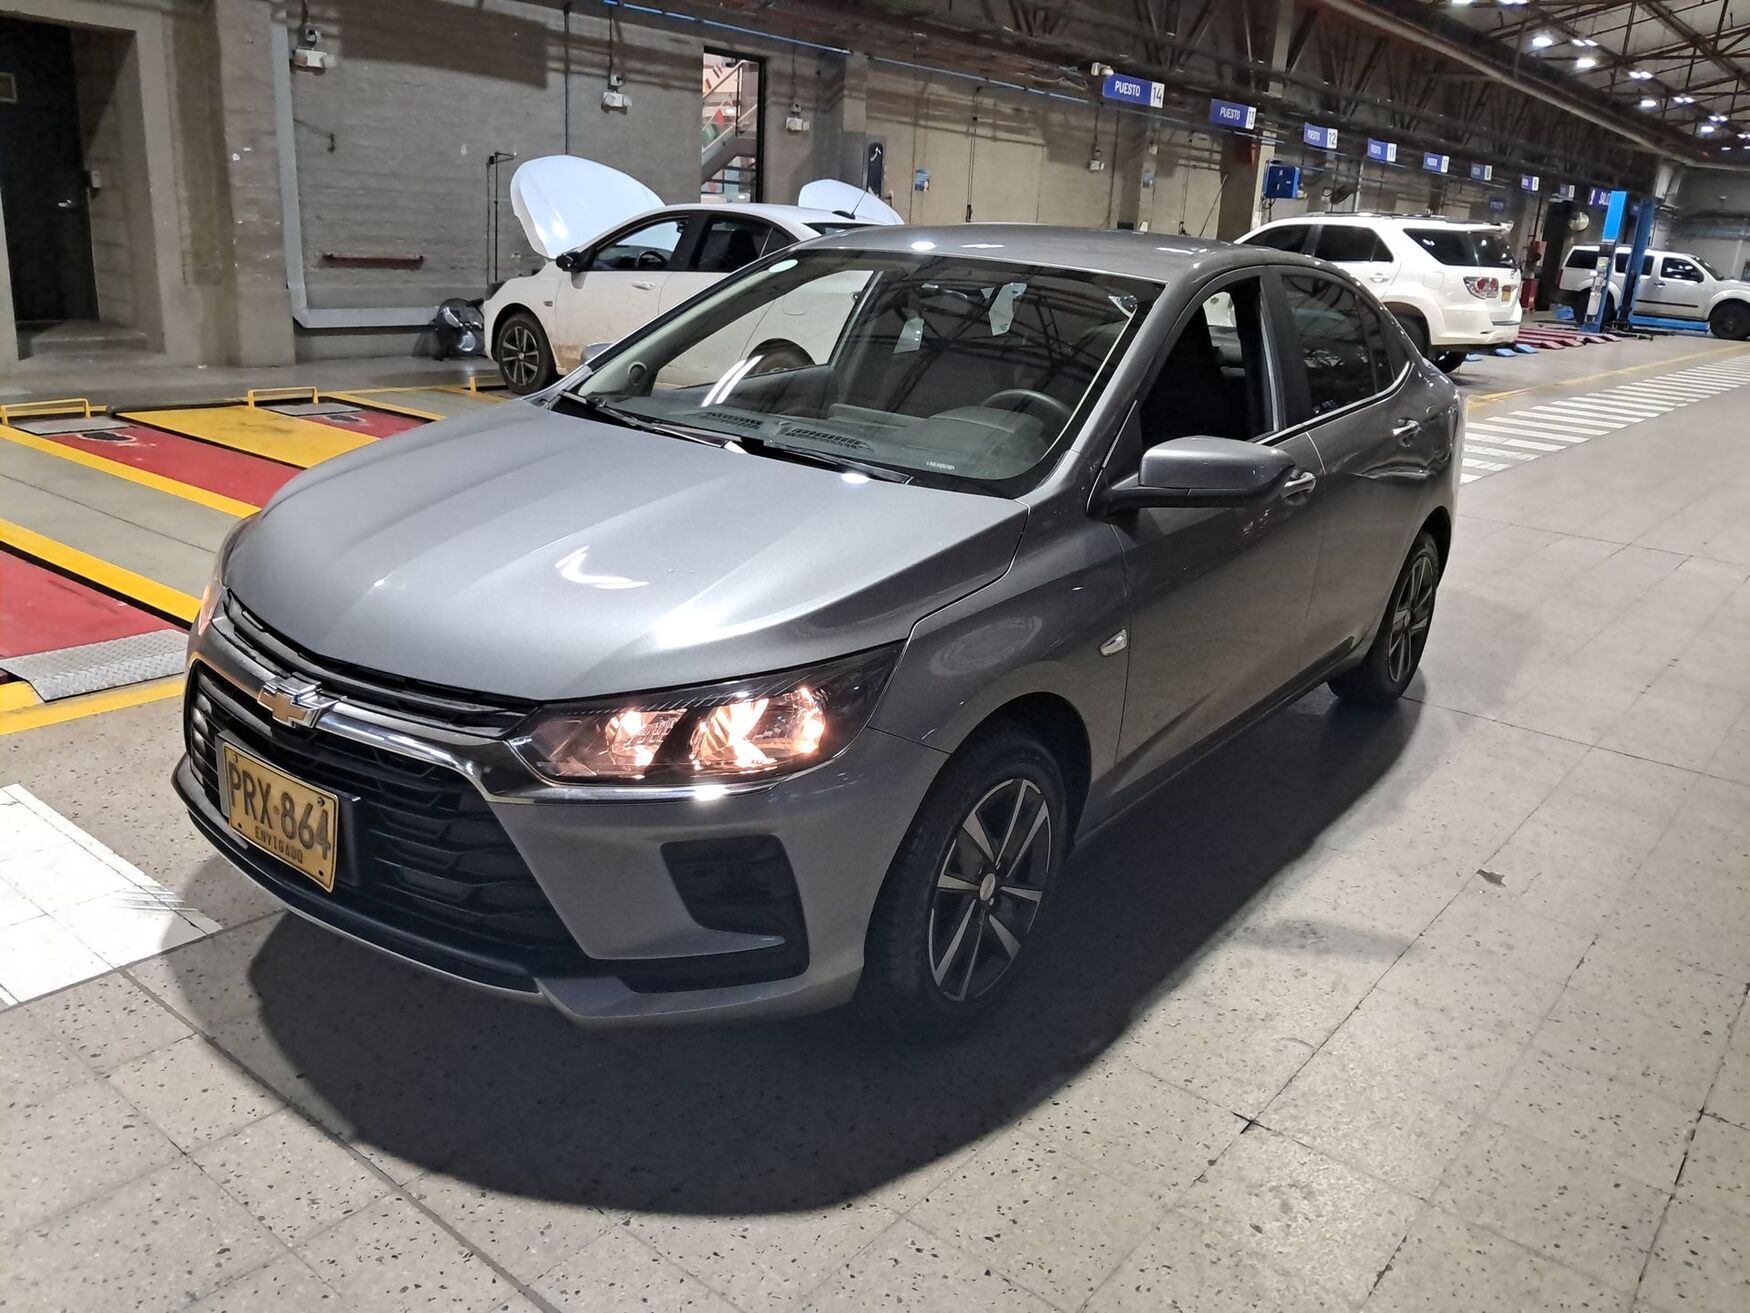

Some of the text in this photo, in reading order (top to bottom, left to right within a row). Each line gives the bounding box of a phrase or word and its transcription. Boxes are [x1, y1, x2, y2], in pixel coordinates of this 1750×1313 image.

[1114, 81, 1162, 103] PUESTO 14
[1219, 107, 1241, 120] PUESTO
[1328, 132, 1337, 145] 12
[1389, 146, 1395, 160] 11
[254, 825, 304, 865] ENVIGADO
